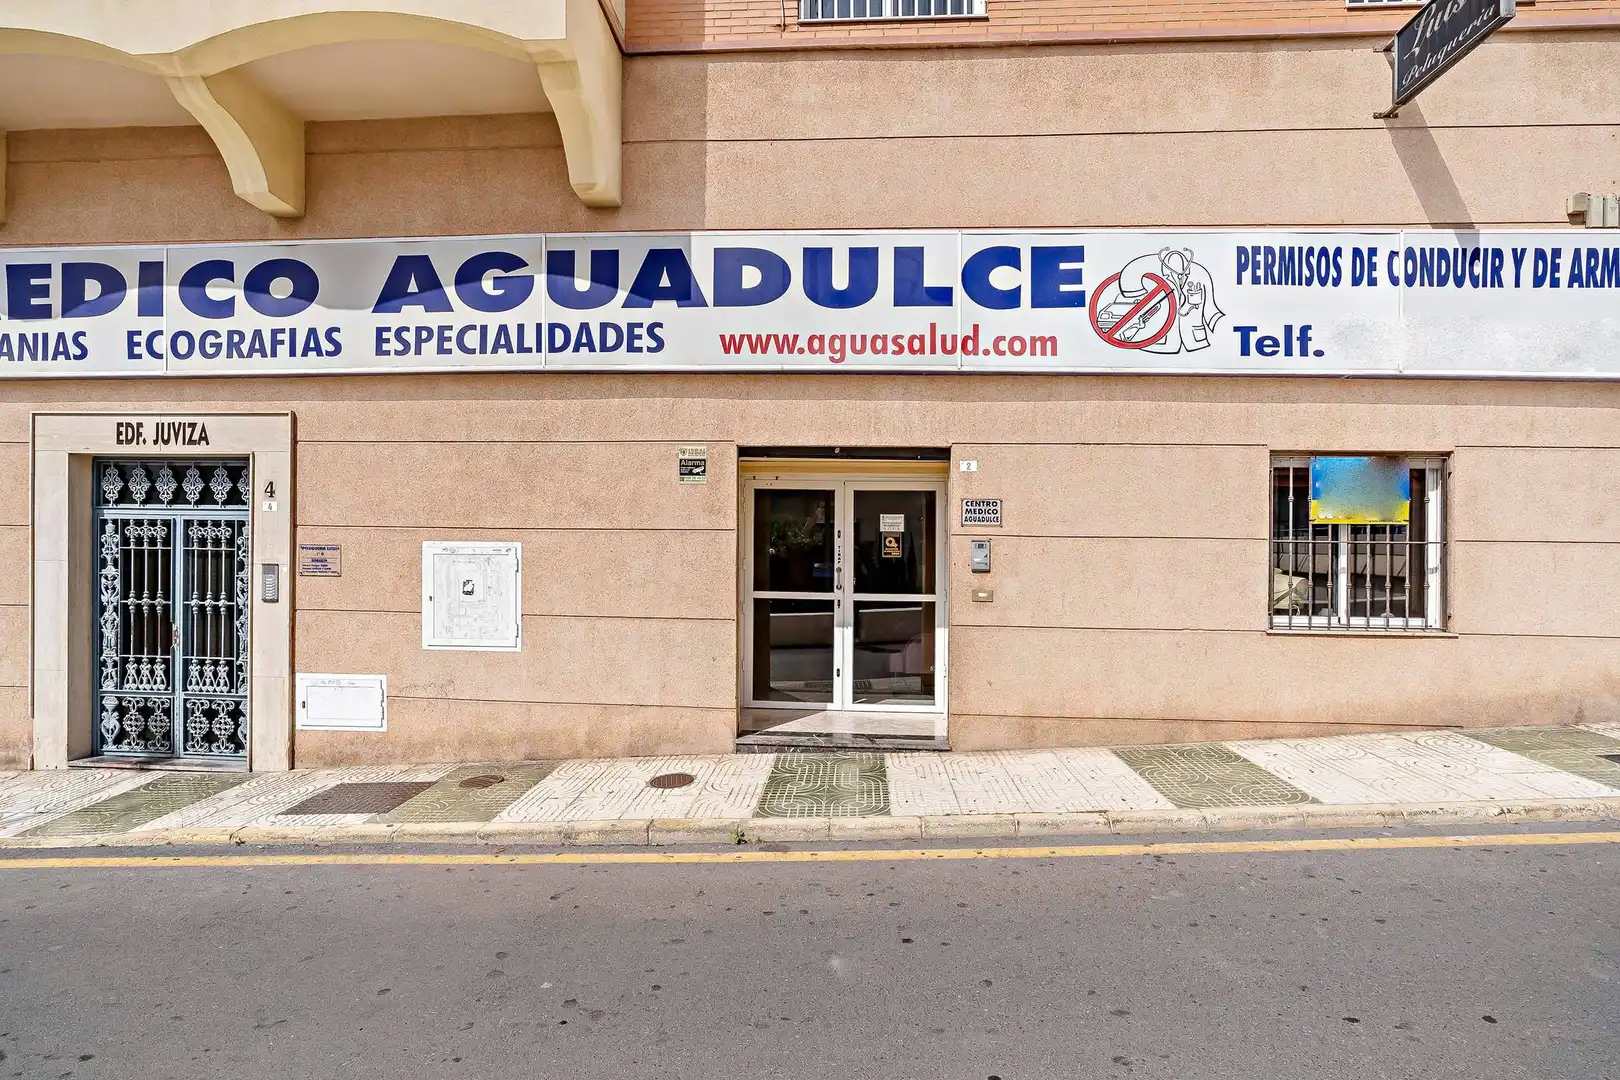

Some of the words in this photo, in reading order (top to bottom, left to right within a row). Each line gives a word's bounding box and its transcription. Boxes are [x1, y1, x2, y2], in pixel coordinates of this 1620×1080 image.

[0, 260, 319, 319] EDICO
[373, 245, 1086, 313] AGUADULCE
[1236, 245, 1343, 287] PERMISOS
[1351, 247, 1378, 287] DE
[1387, 247, 1505, 289] CONDUCIR
[1511, 247, 1527, 288] Y
[1532, 247, 1562, 288] DE
[126, 327, 341, 360] ECOGRAFIAS
[375, 322, 664, 356] ESPECIALIDADES
[720, 322, 1058, 363] www.aguasalud.com
[1232, 325, 1325, 357] Telf.
[116, 421, 147, 446] EDF.
[152, 421, 210, 446] JUVIZA
[966, 462, 972, 471] 2
[264, 480, 276, 499] 4
